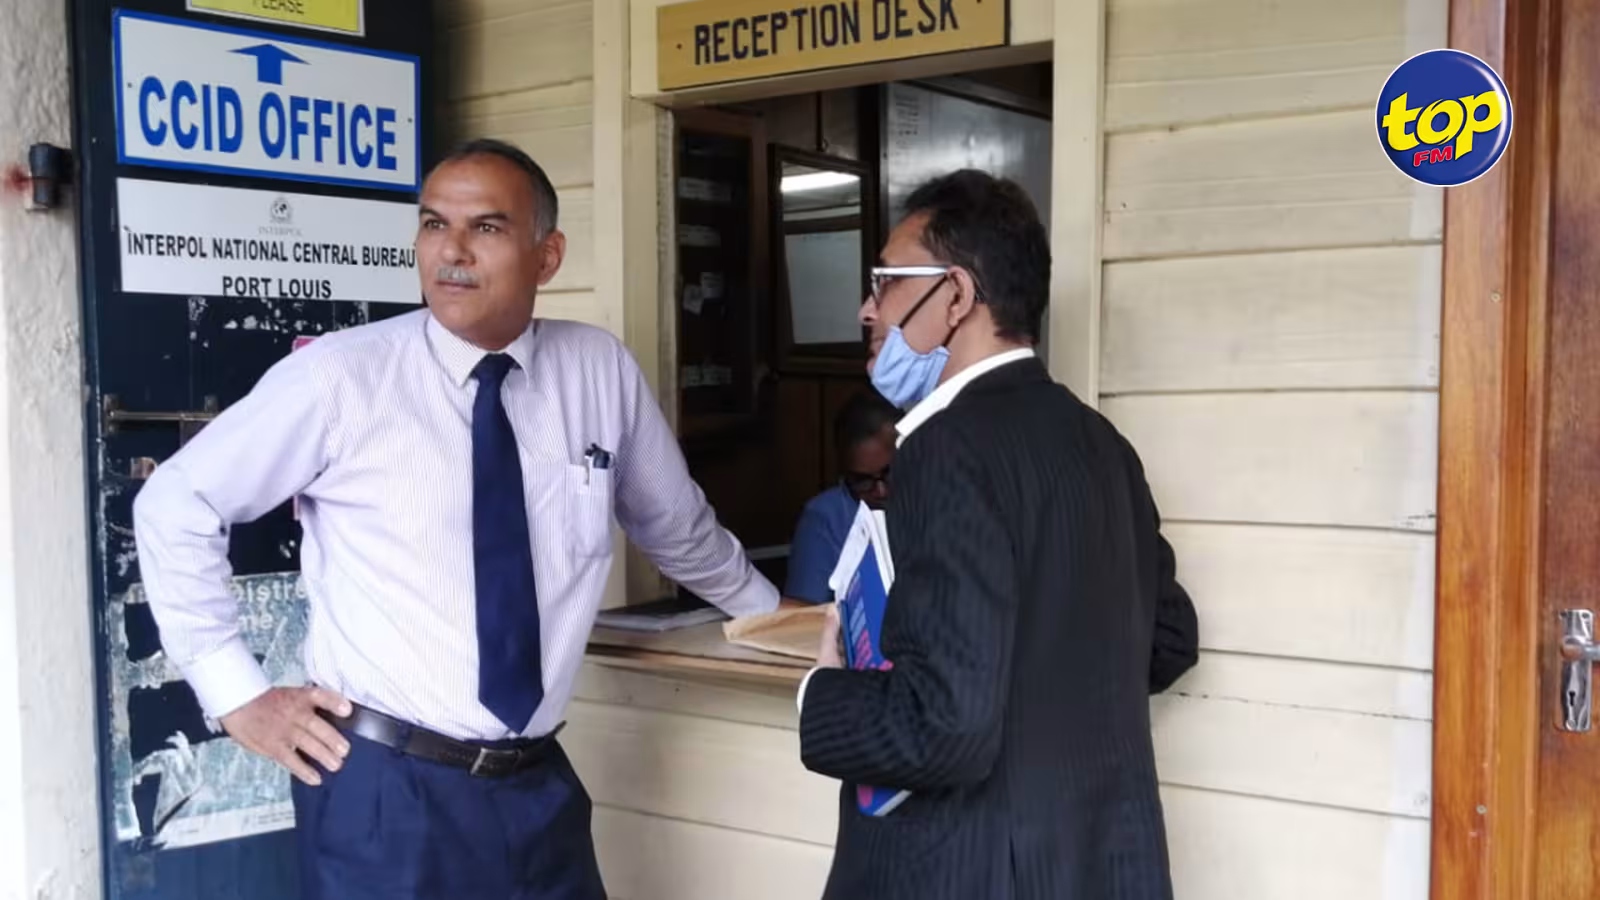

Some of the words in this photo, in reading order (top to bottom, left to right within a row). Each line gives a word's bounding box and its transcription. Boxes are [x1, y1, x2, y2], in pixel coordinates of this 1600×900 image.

[694, 0, 860, 66] RECEPTION
[873, 0, 959, 41] DESK
[138, 76, 243, 154] CCID
[258, 91, 398, 170] OFFICE
[127, 231, 207, 259] INTERPOL
[212, 237, 289, 263] NATIONAL
[293, 241, 358, 266] CENTRAL
[362, 245, 416, 268] BUREAU
[222, 276, 272, 297] PORT
[279, 278, 332, 299] LOUIS
